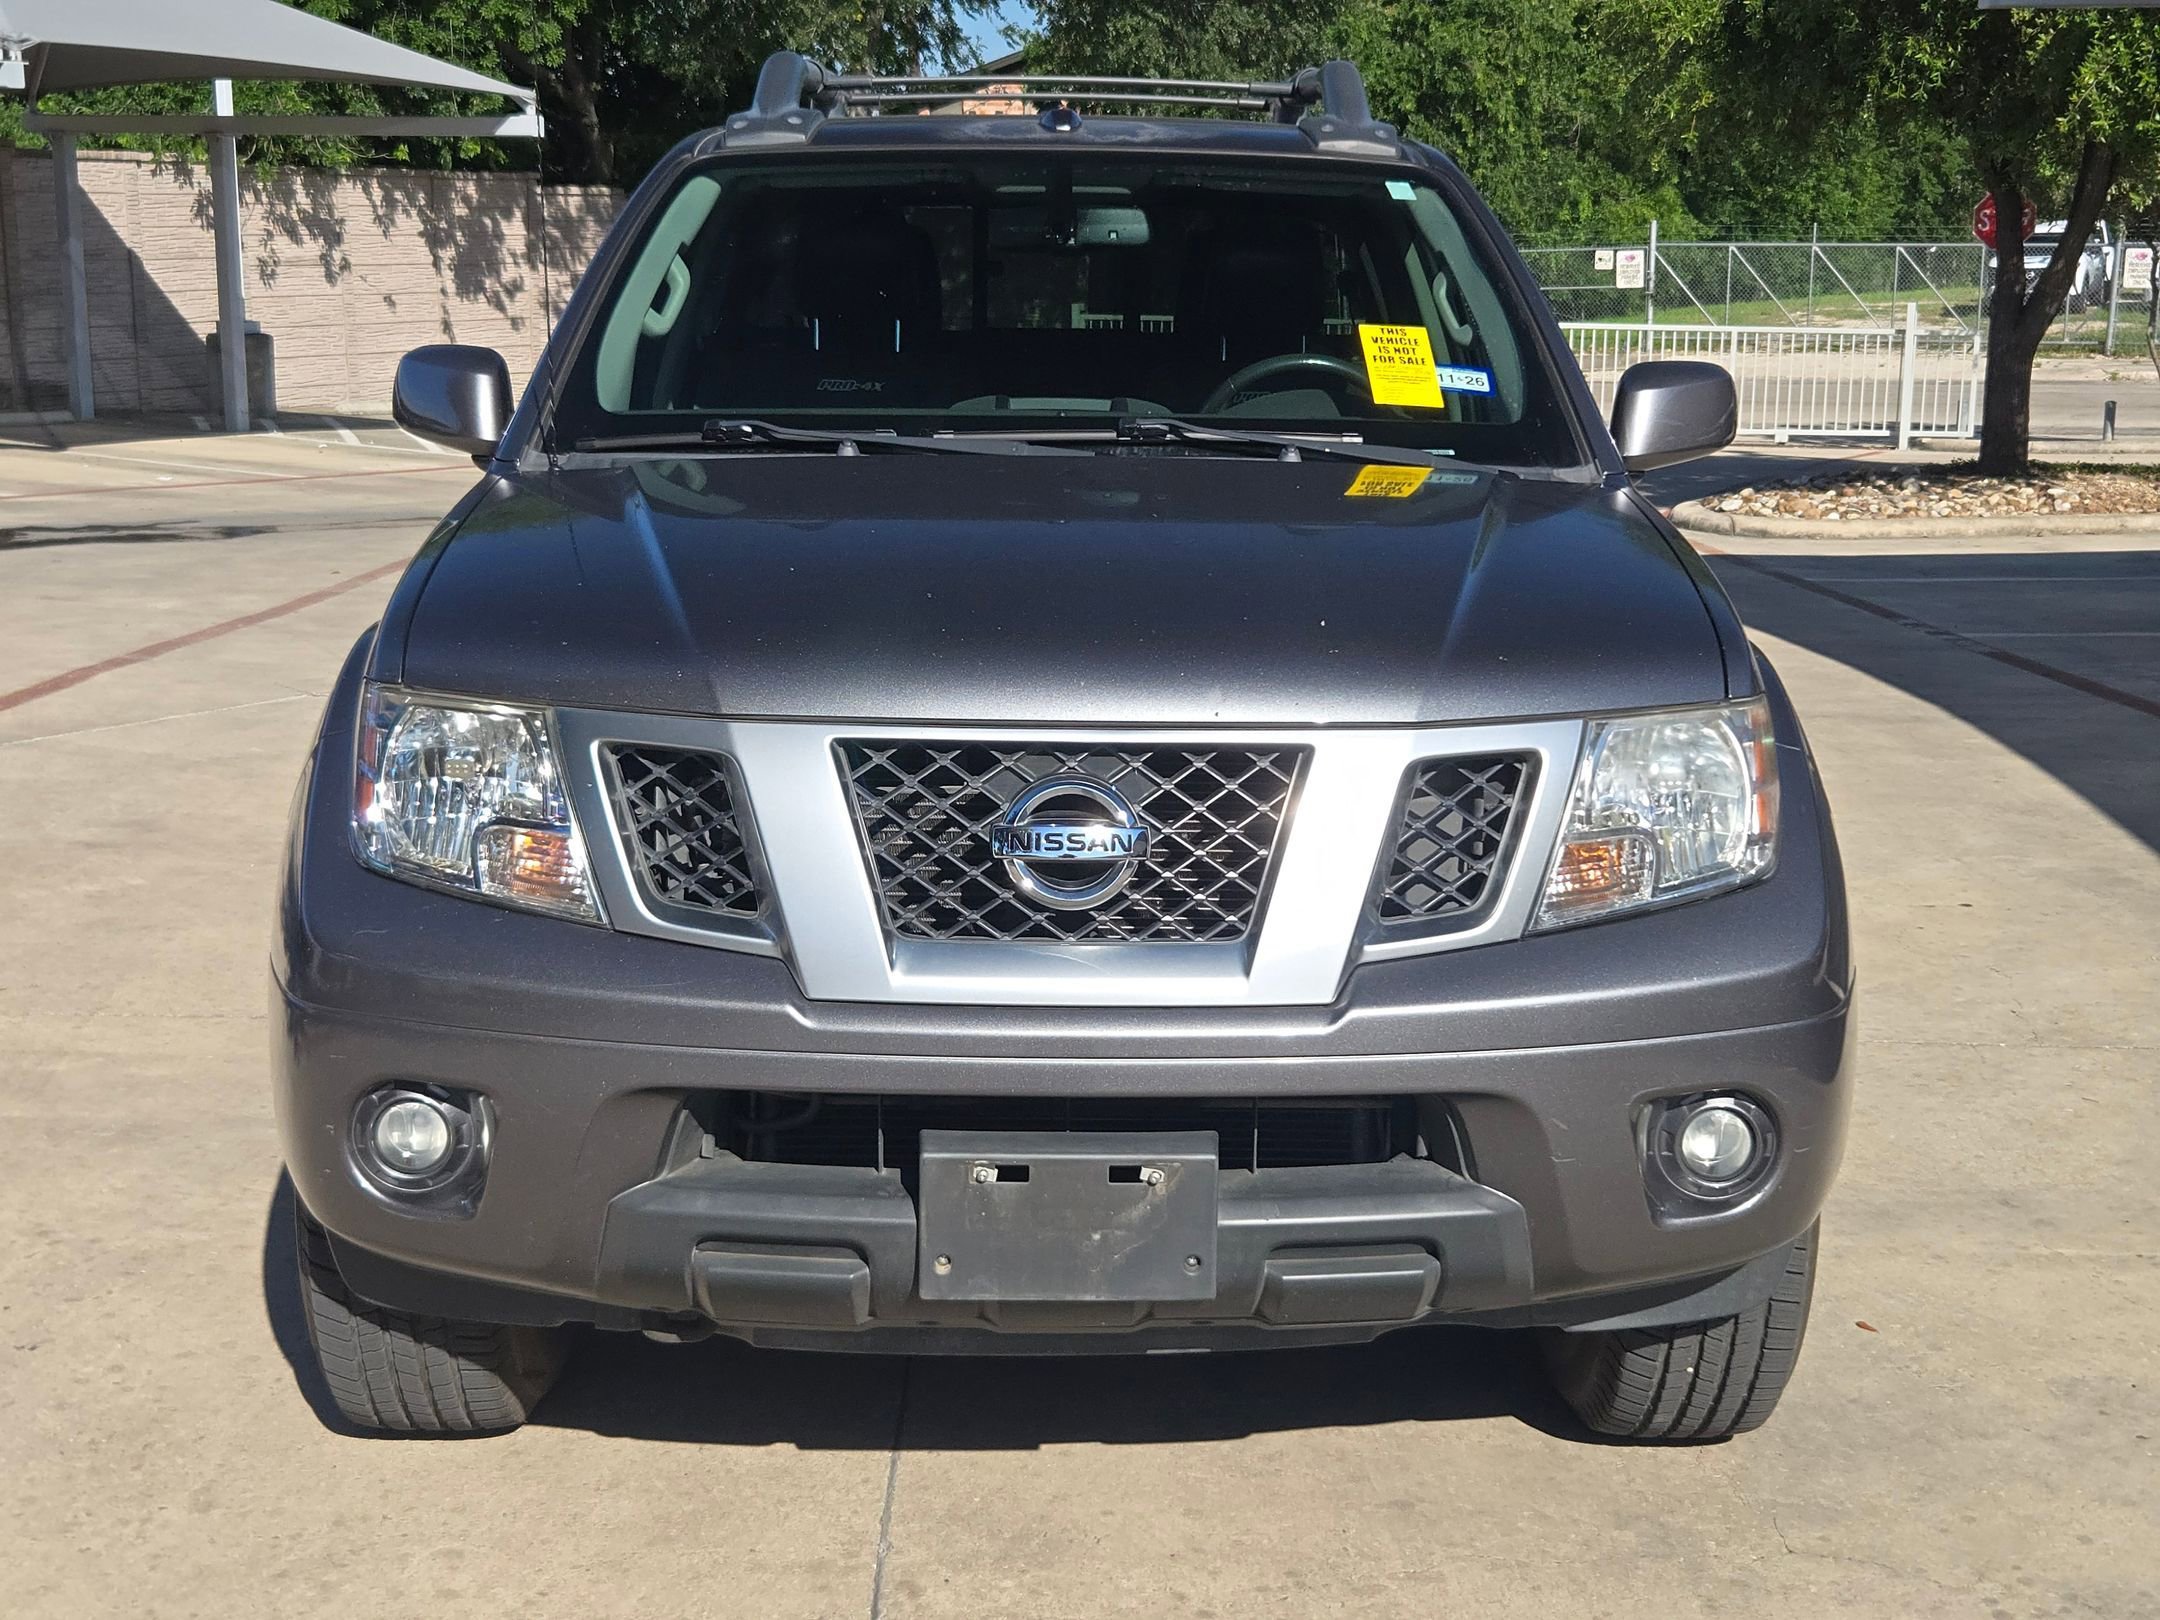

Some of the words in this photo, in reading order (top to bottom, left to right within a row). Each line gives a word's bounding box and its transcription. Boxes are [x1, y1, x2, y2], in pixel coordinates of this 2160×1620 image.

[1380, 327, 1407, 336] THIS
[1371, 336, 1420, 346] VEHICLE
[1378, 346, 1390, 354] IS
[1394, 347, 1417, 355] NOT
[1373, 355, 1395, 364] FOR
[1399, 356, 1427, 366] SALE
[1465, 375, 1485, 387] 26
[1009, 832, 1134, 853] NISSAN
